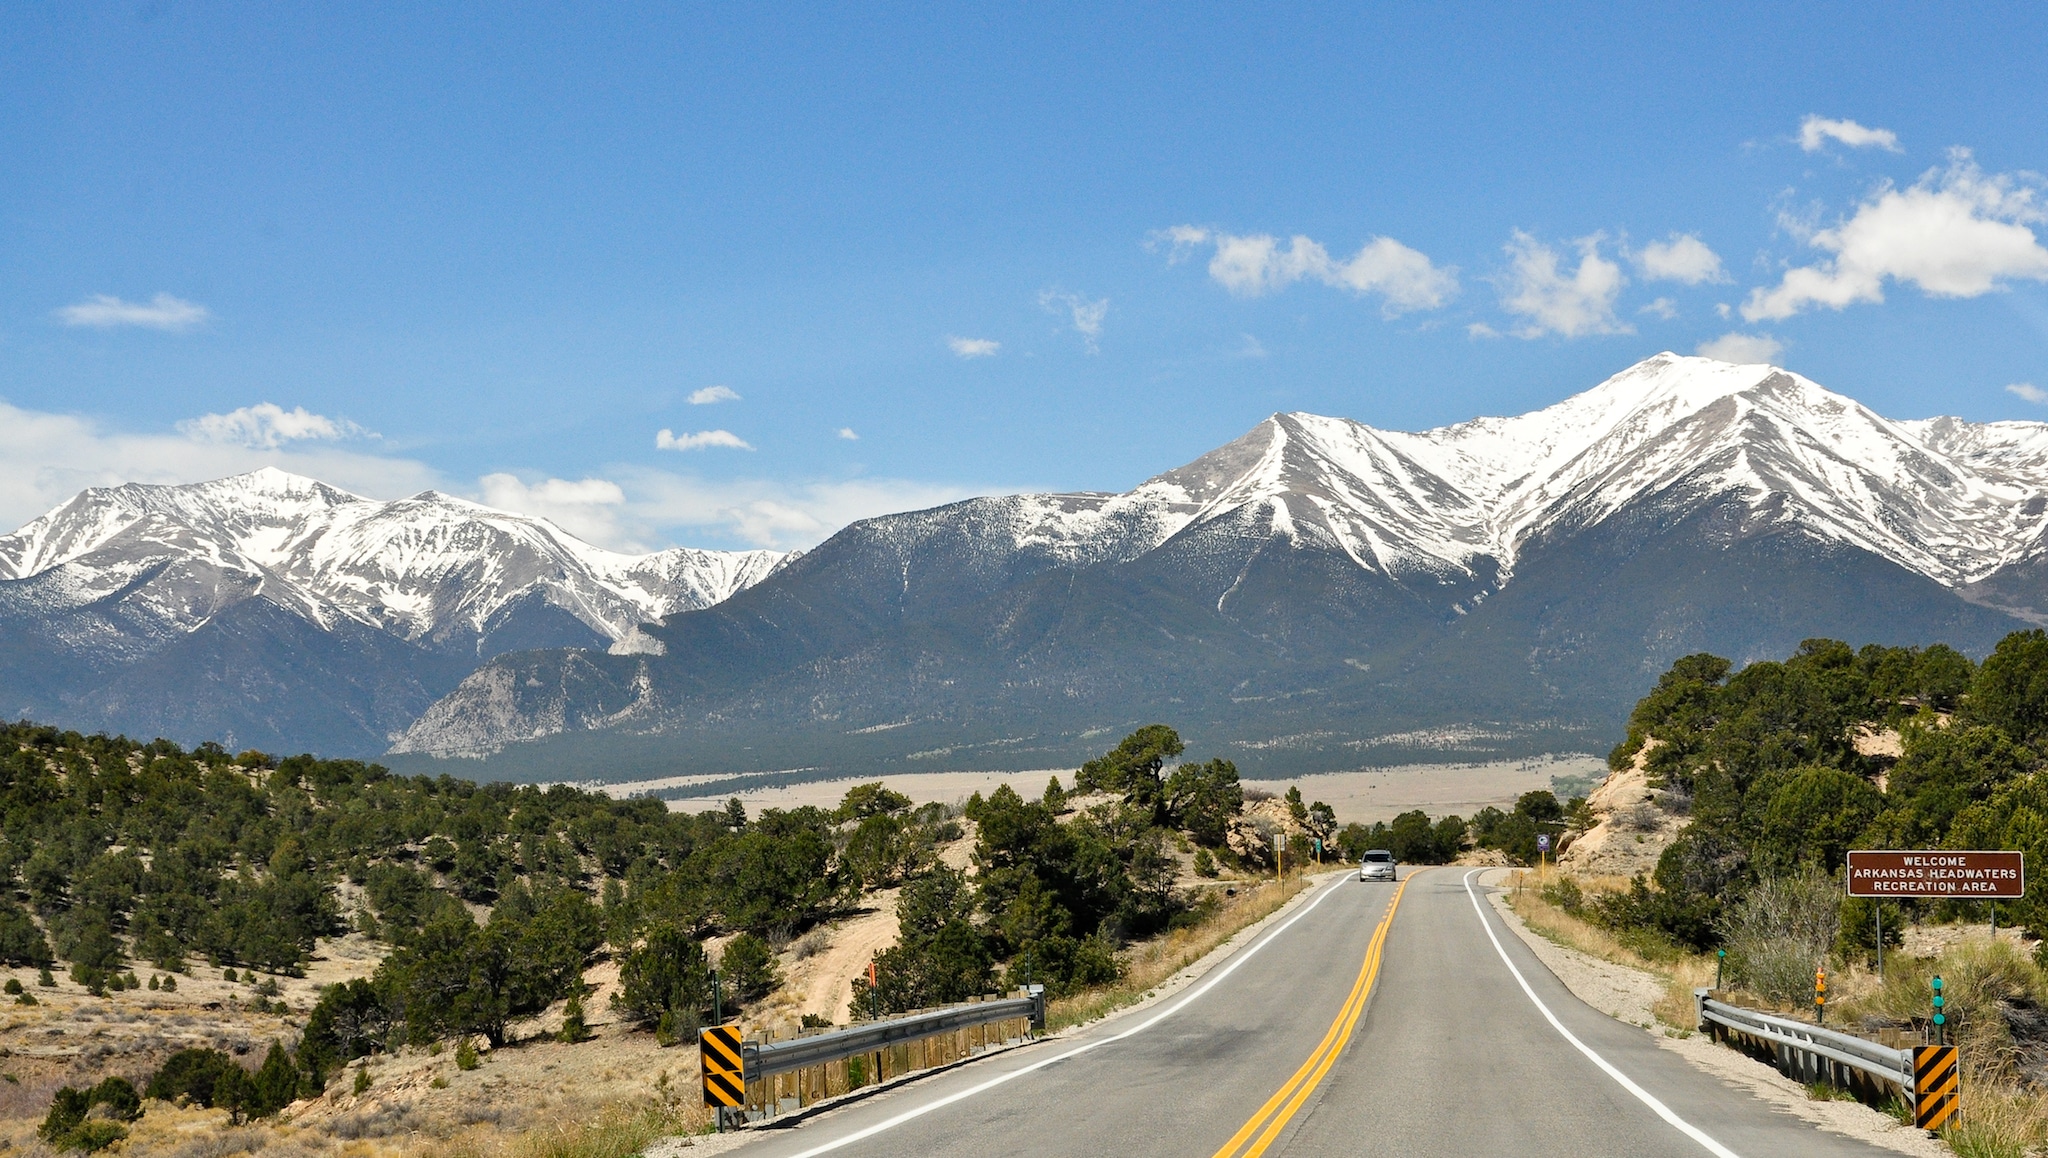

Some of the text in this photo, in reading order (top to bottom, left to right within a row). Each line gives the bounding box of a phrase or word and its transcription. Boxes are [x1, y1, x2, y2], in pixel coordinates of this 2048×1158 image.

[1903, 856, 1966, 866] WELCOME
[1854, 869, 2017, 879] ARKANSAS HEADWATERS
[1874, 881, 1997, 892] RECREATION AREA
